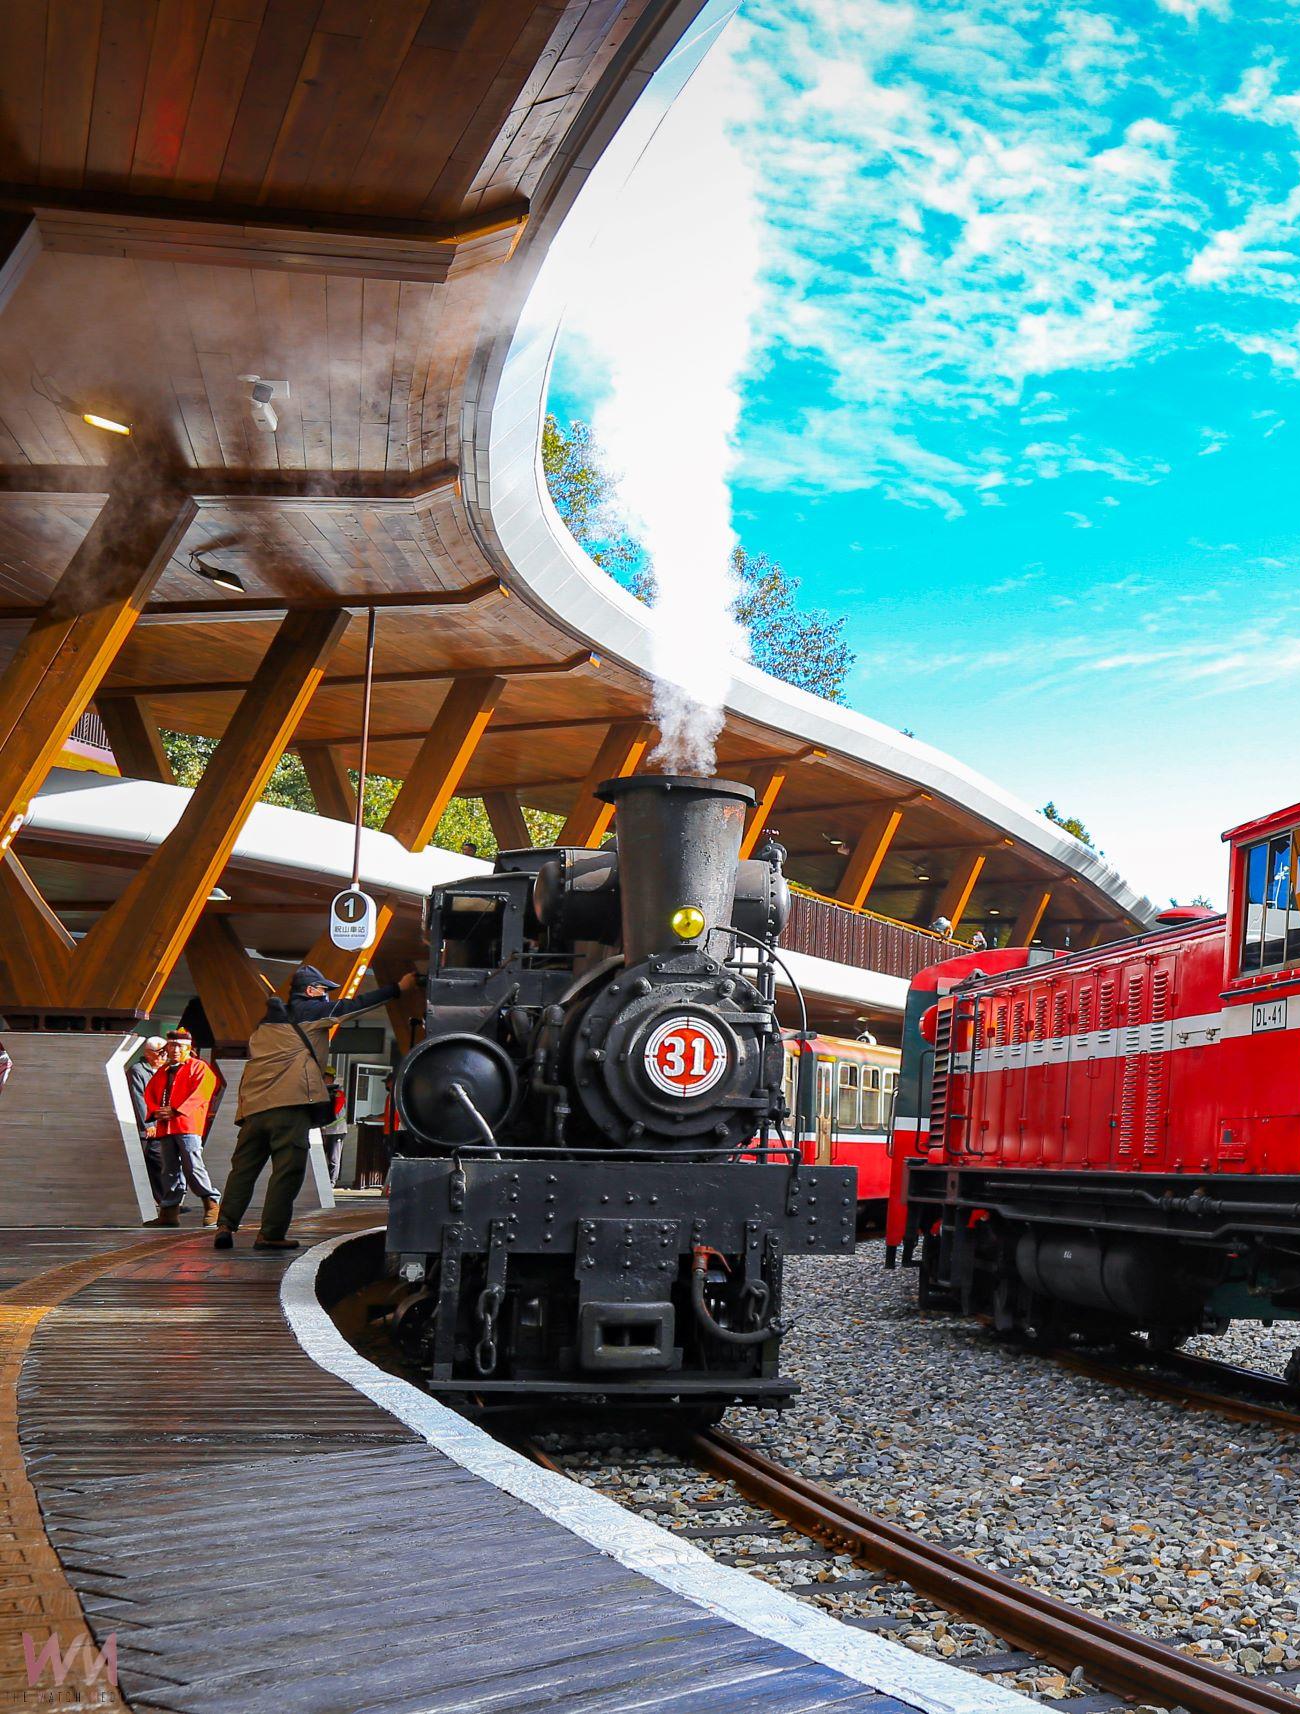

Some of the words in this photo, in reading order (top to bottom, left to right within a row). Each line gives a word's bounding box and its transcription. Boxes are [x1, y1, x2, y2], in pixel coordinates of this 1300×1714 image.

[344, 898, 355, 918] 1
[1256, 1004, 1282, 1027] DL-41
[662, 1036, 707, 1077] 31
